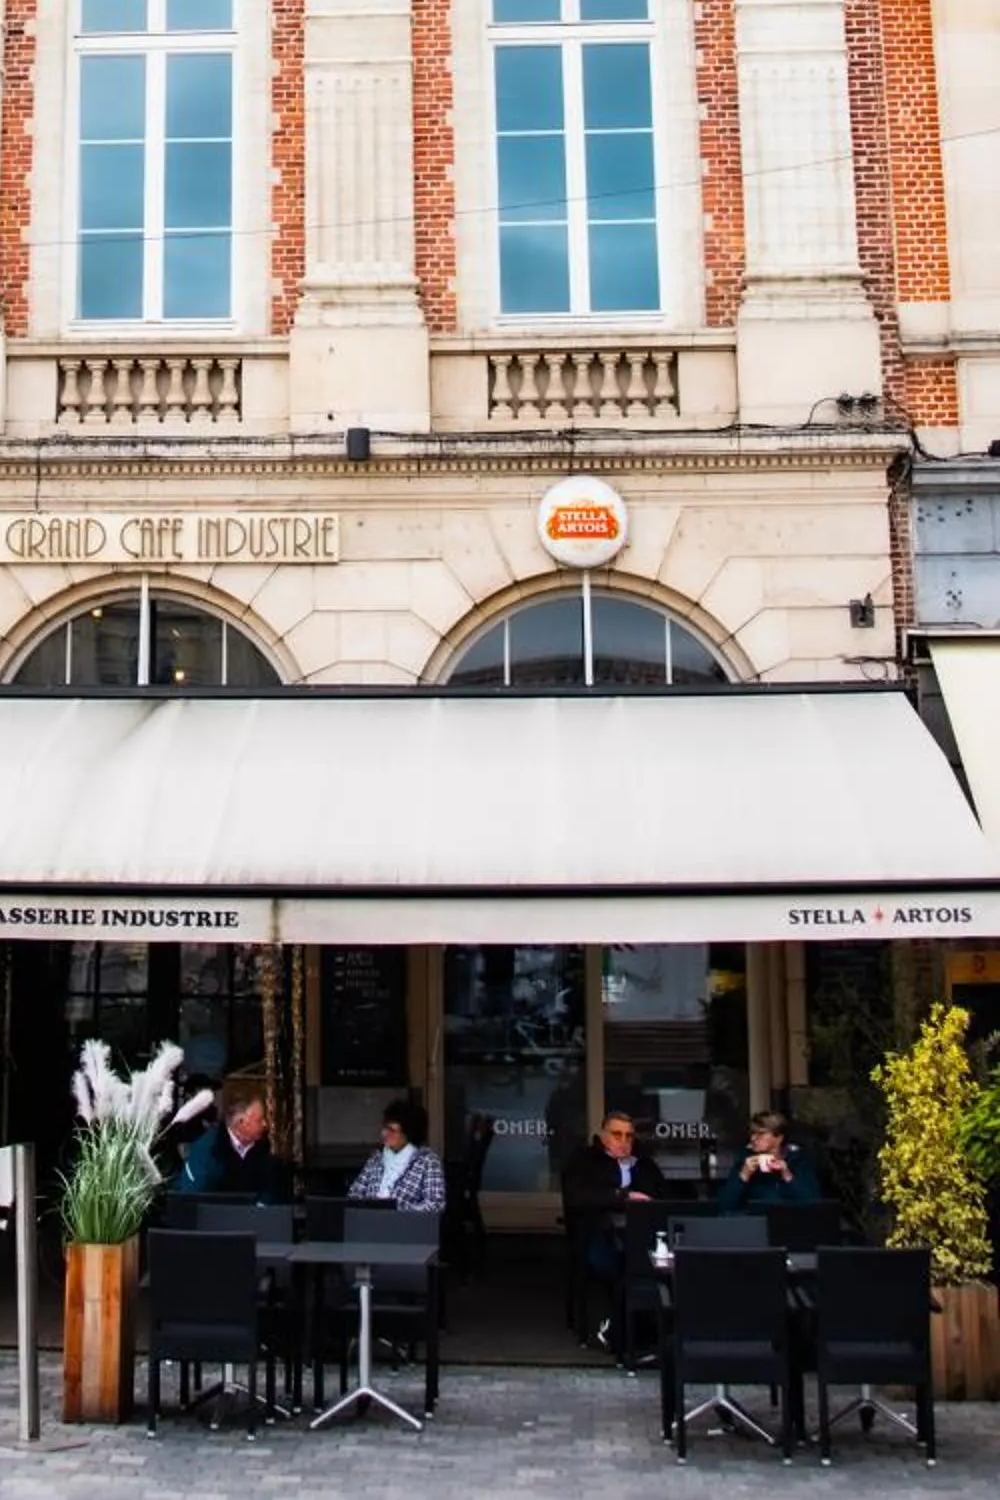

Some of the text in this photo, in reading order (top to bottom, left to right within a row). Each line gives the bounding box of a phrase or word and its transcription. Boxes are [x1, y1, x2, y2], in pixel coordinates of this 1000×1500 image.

[558, 510, 608, 521] STELLA
[558, 522, 608, 533] ARTOIS
[5, 517, 107, 559] GRAND
[198, 516, 336, 559] INDUSTRIE
[101, 908, 240, 928] INDUSTRIE
[788, 907, 973, 925] STELLA ARTOIS
